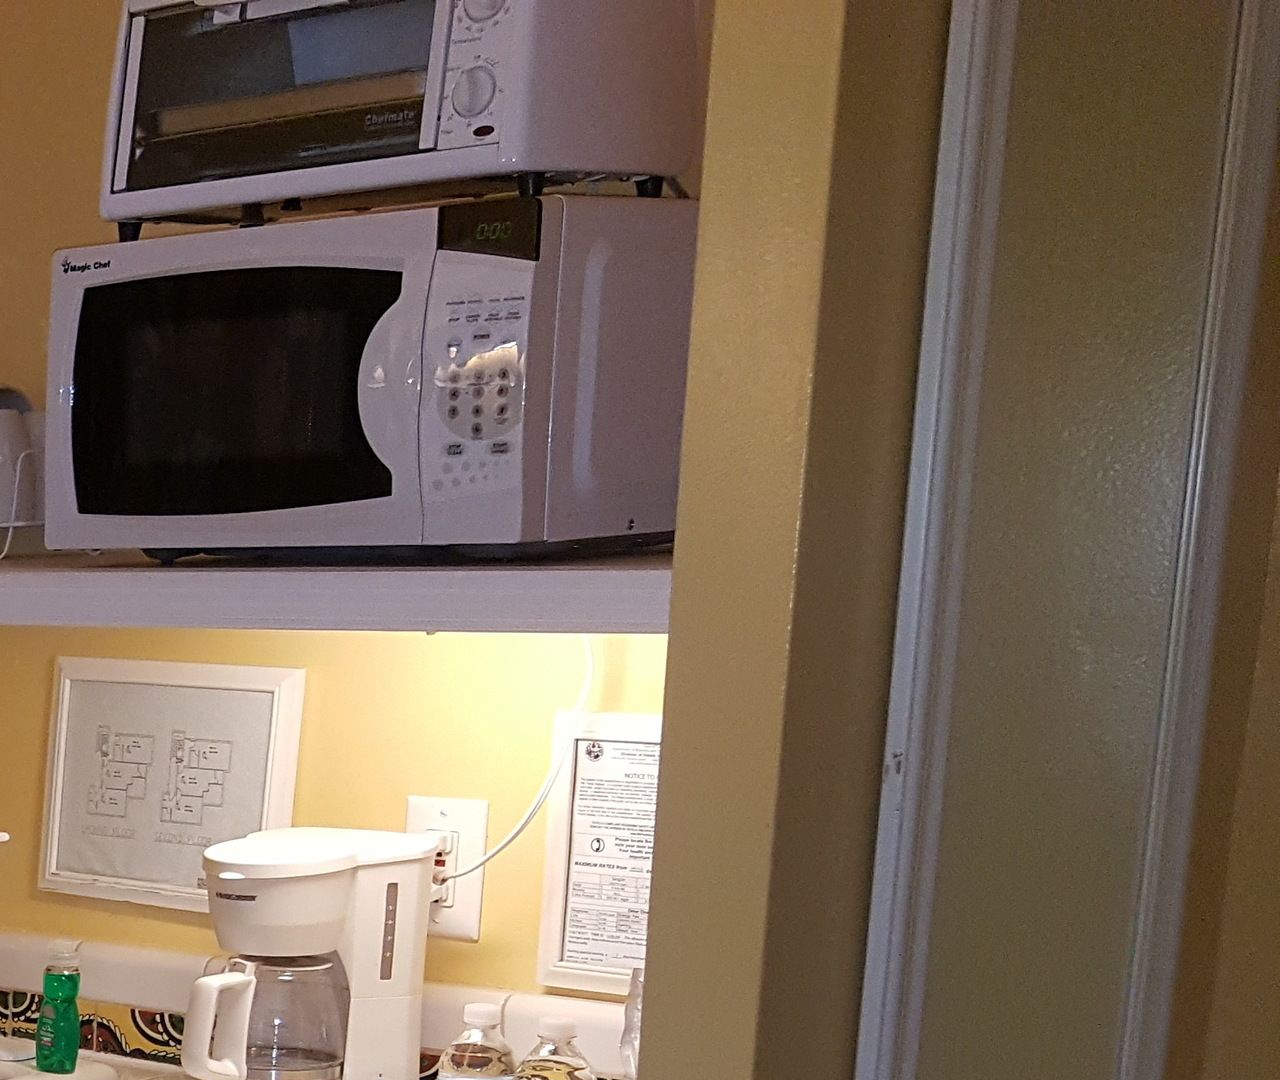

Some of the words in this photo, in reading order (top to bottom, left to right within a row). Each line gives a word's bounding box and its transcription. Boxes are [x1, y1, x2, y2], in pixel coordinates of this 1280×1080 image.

[70, 262, 91, 273] Magic
[93, 260, 111, 270] Chef
[624, 772, 645, 780] NOTICE
